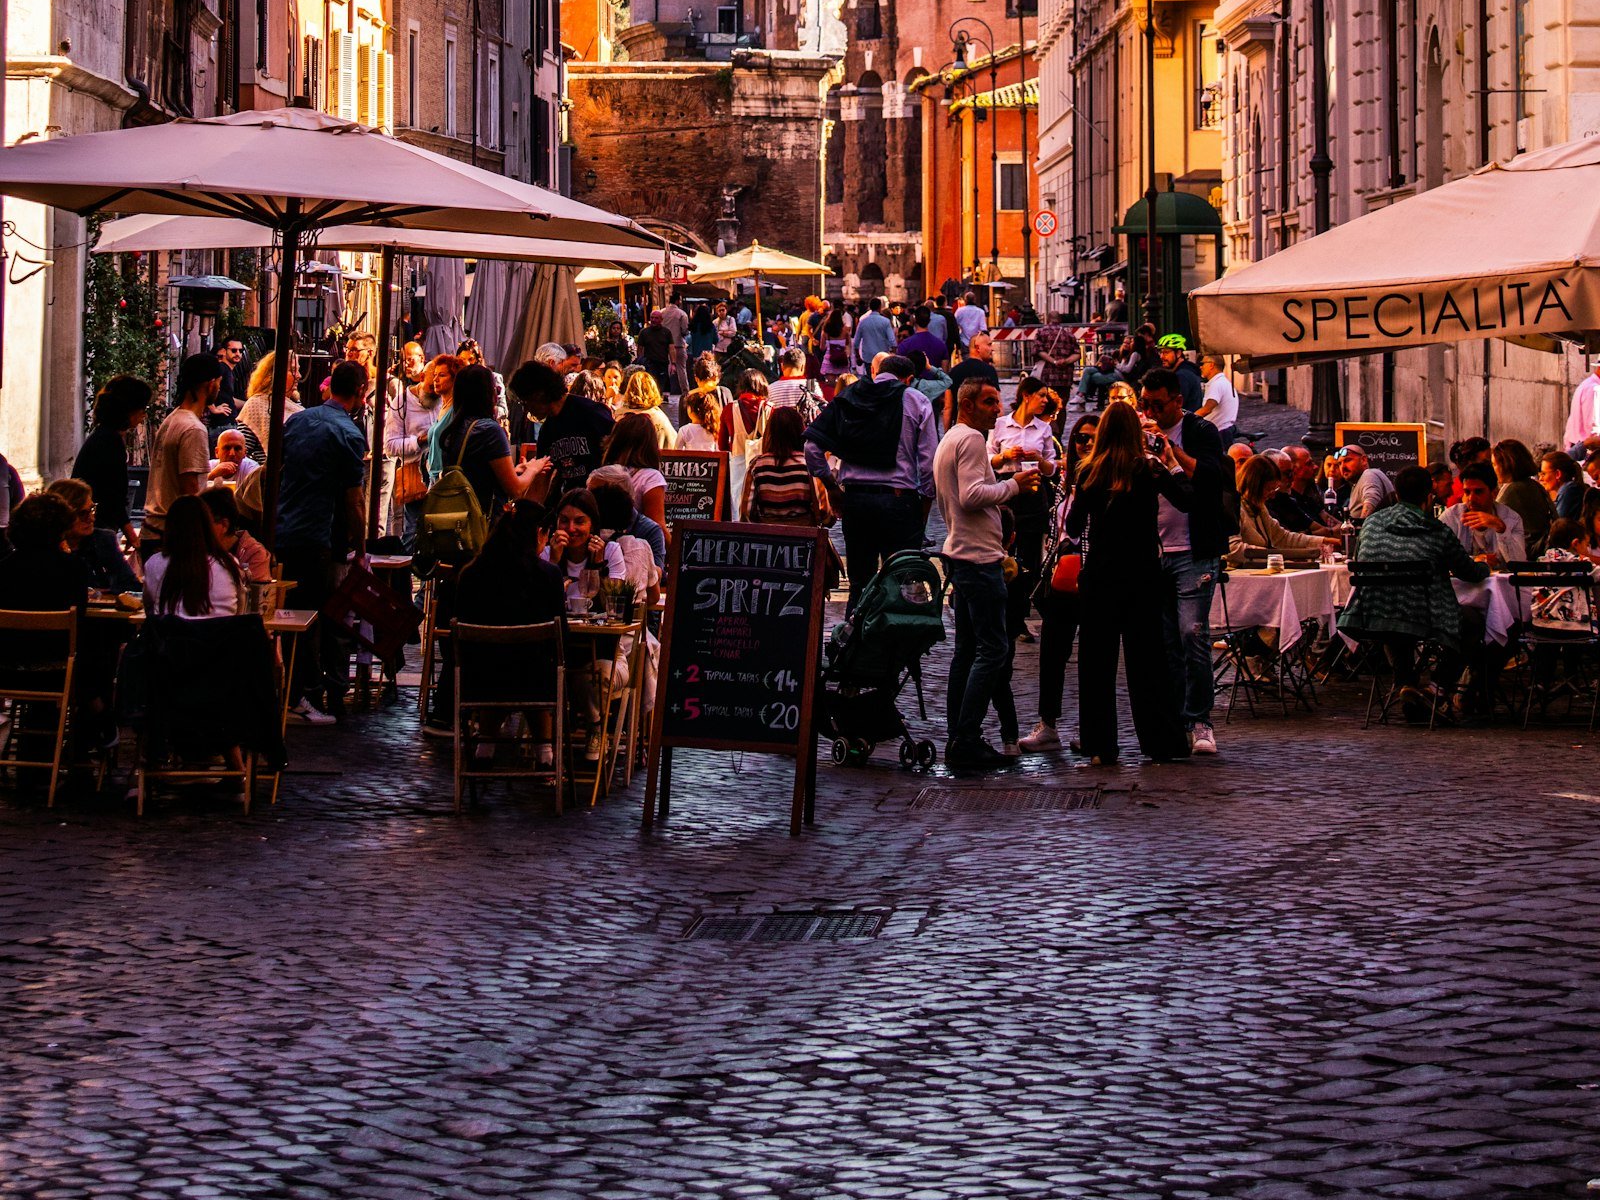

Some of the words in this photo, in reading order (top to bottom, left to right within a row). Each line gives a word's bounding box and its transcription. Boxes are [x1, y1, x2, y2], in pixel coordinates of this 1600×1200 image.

[551, 436, 591, 461] ONDON
[659, 461, 718, 477] REAKFAST
[685, 538, 806, 569] APERITIME
